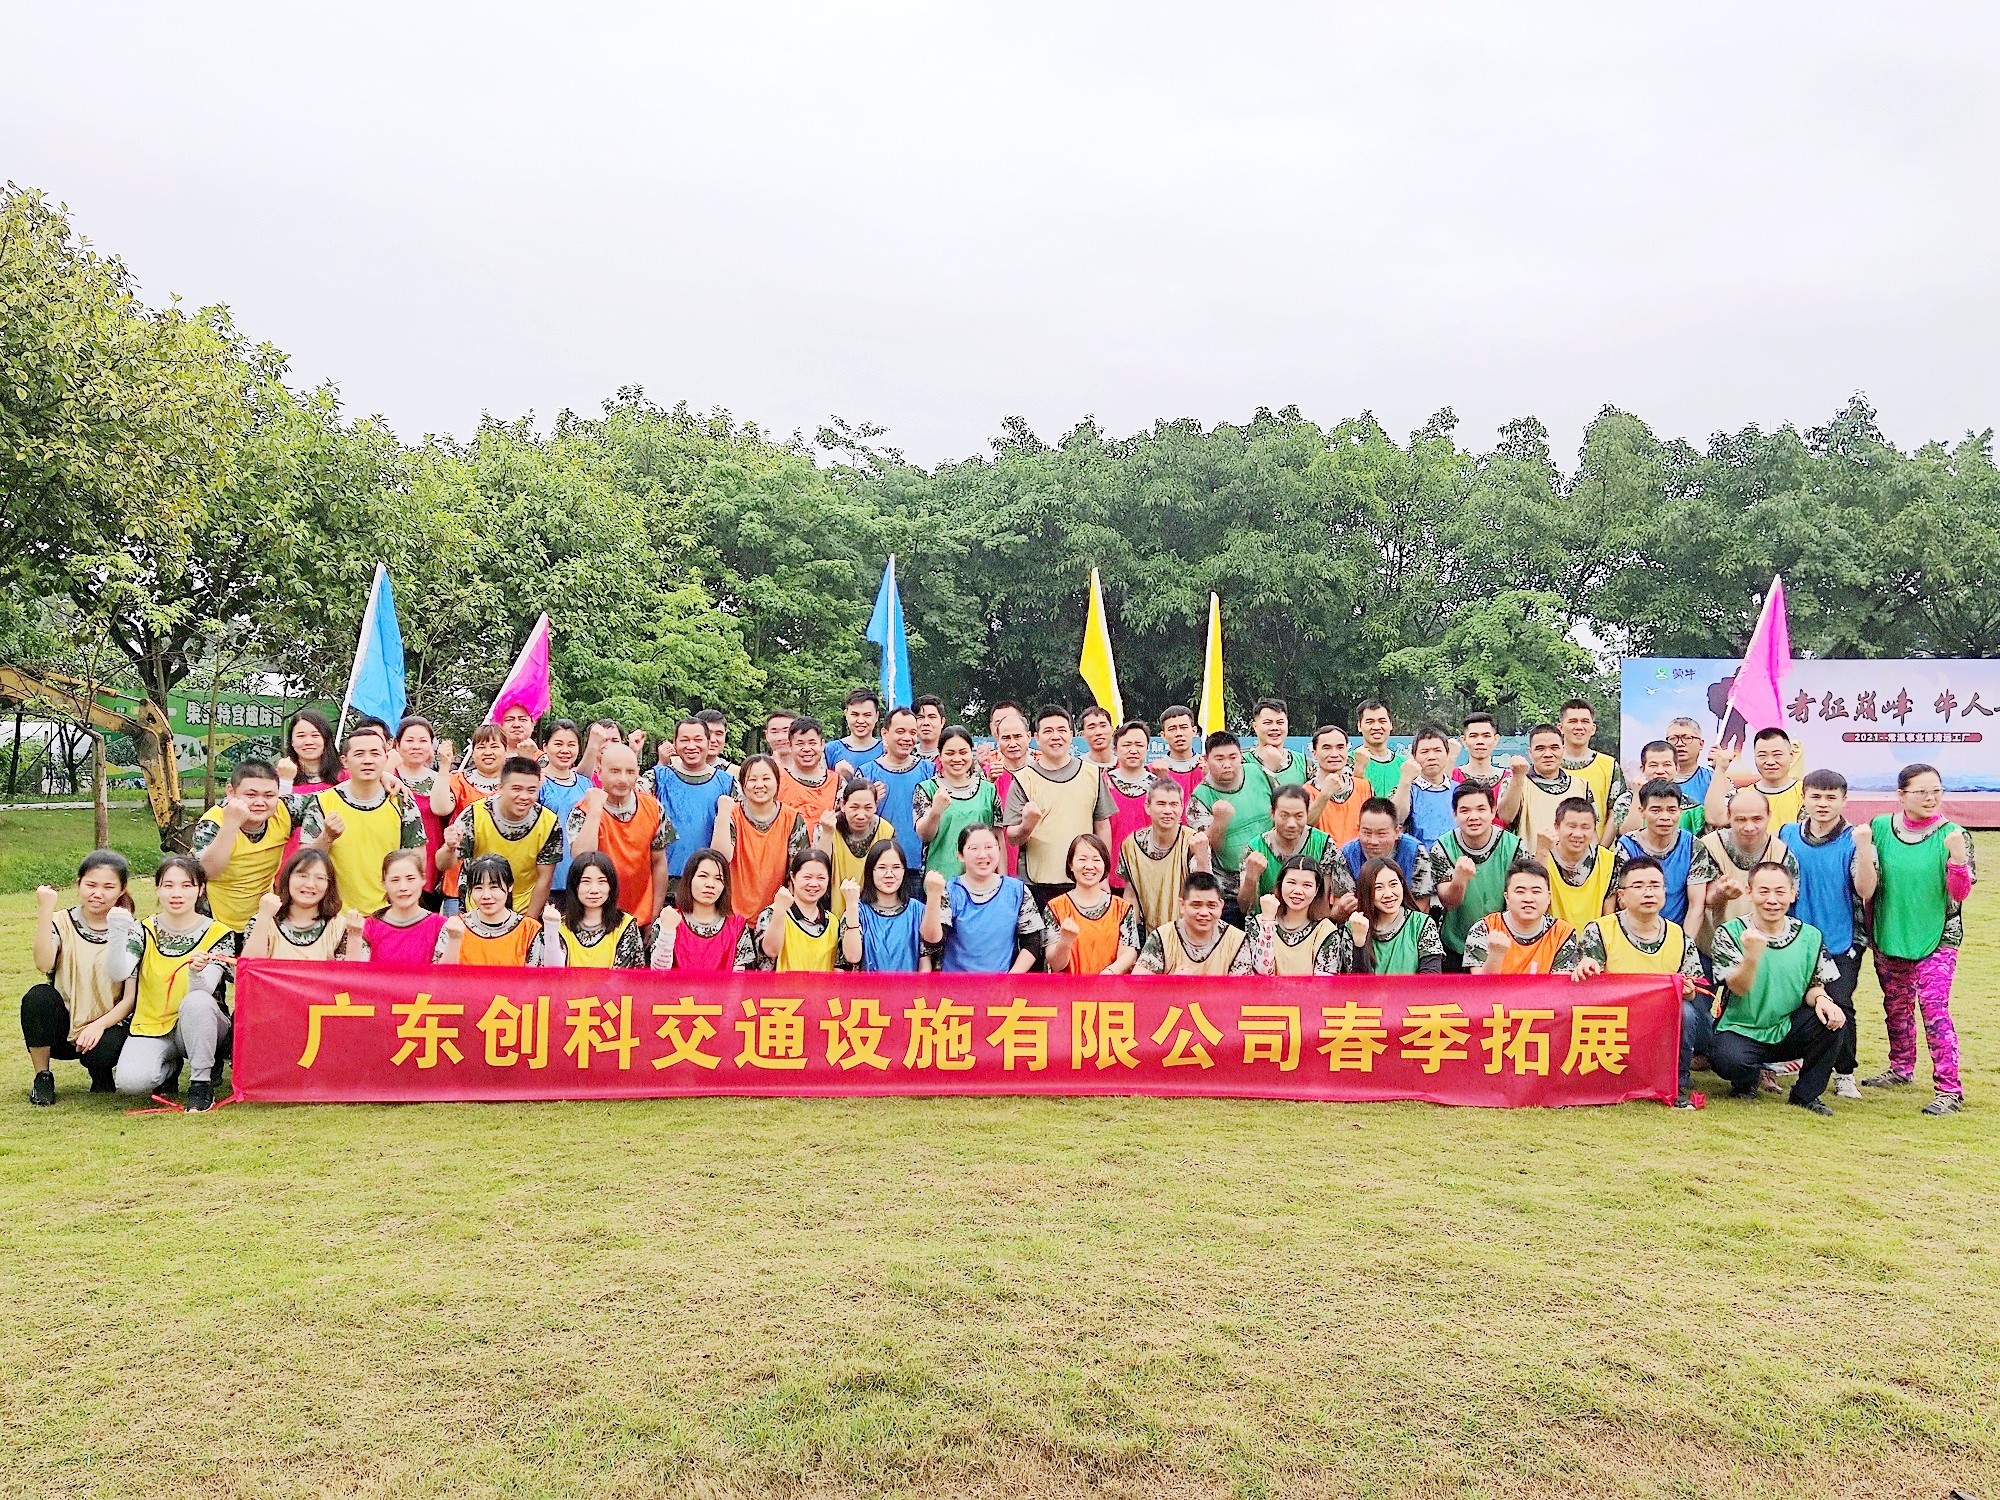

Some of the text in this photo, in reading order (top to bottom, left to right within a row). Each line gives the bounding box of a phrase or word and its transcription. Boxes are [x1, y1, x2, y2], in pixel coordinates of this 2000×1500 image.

[1672, 668, 1696, 680] 蒙牛
[1933, 688, 2000, 724] 牛人
[297, 991, 1632, 1076] 广东创科交通设施有限公司春季拓展
